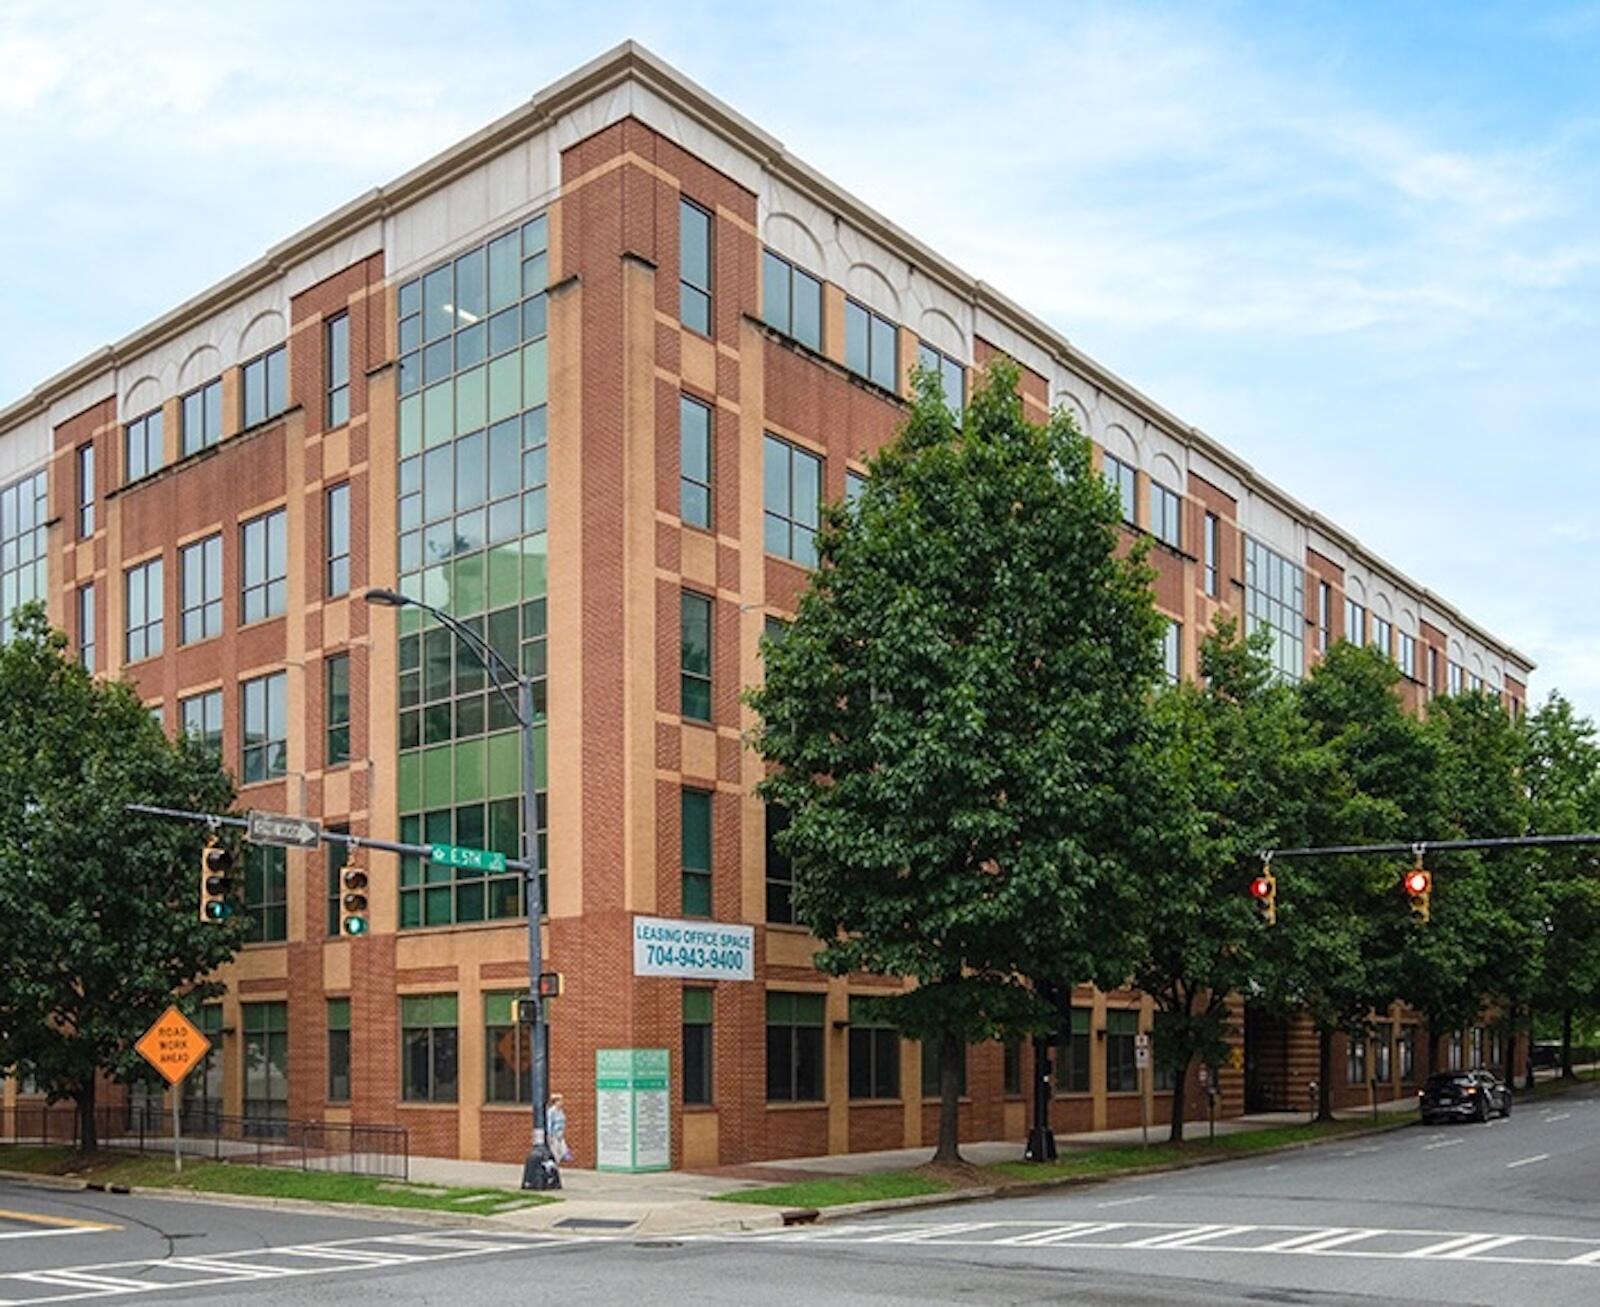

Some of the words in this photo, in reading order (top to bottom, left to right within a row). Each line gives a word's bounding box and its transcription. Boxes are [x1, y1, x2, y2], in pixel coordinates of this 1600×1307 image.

[637, 926, 680, 942] LEASING
[684, 931, 717, 946] OFFICE
[721, 934, 750, 950] SPACE
[646, 944, 742, 970] 704-943-9400
[158, 1026, 188, 1038] ROAD
[159, 1040, 187, 1051] WORK
[160, 1053, 189, 1064] AHEAD
